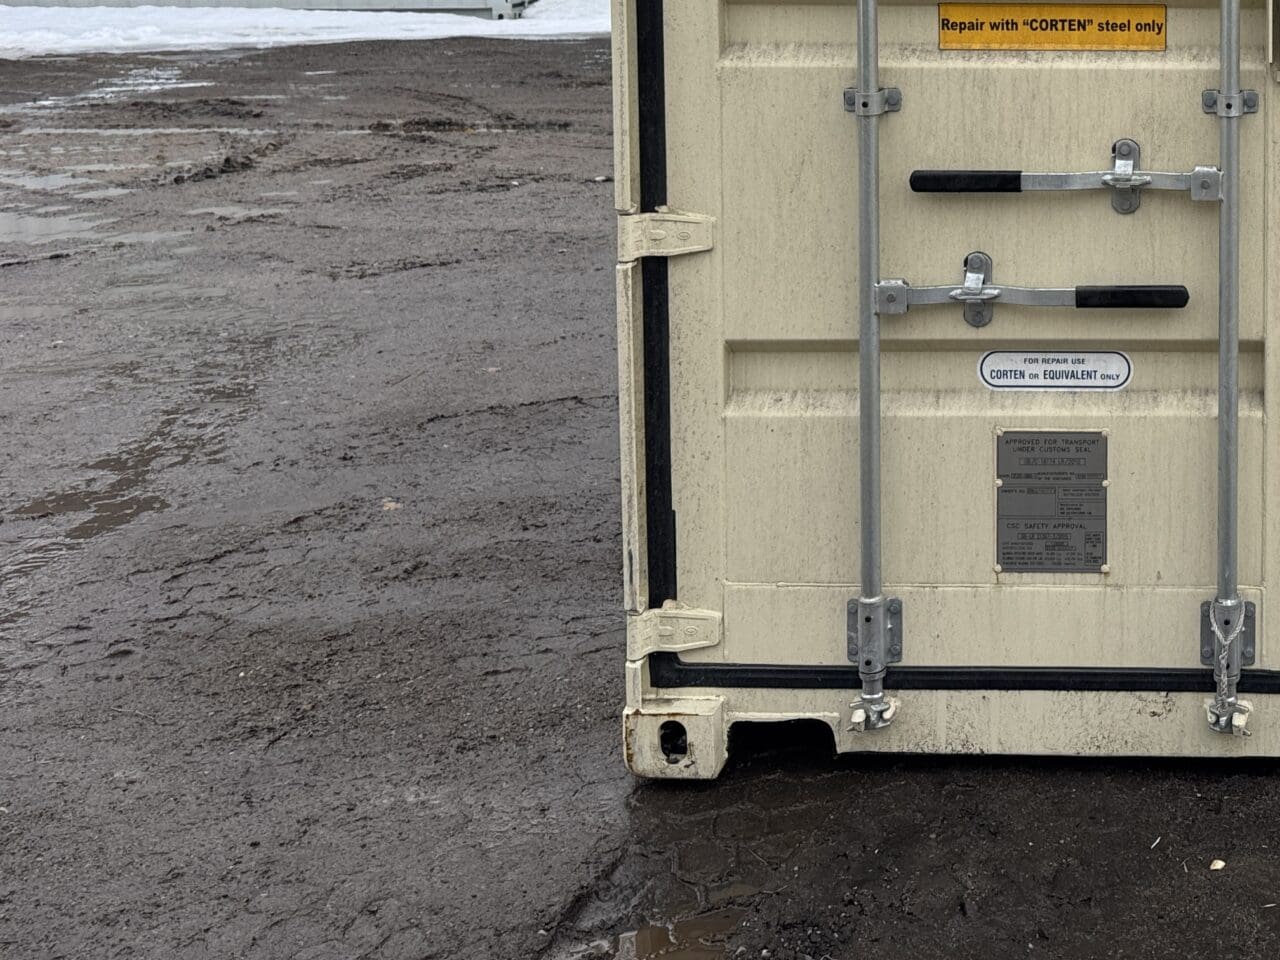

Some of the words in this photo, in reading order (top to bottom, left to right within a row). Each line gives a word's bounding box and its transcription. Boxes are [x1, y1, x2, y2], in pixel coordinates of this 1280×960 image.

[941, 18, 985, 34] Repair
[989, 18, 1019, 32] with
[1097, 19, 1131, 32] steel
[1135, 20, 1164, 36] only
[1023, 357, 1039, 365] FOR
[1041, 357, 1069, 365] REPAIR
[990, 369, 1026, 380] CORTEN
[1043, 369, 1098, 380] EQUIVALENT
[1100, 373, 1121, 381] ONLY
[1006, 522, 1021, 530] CSC
[1024, 522, 1049, 530] SAFETY
[1052, 522, 1087, 530] APPROVAL
